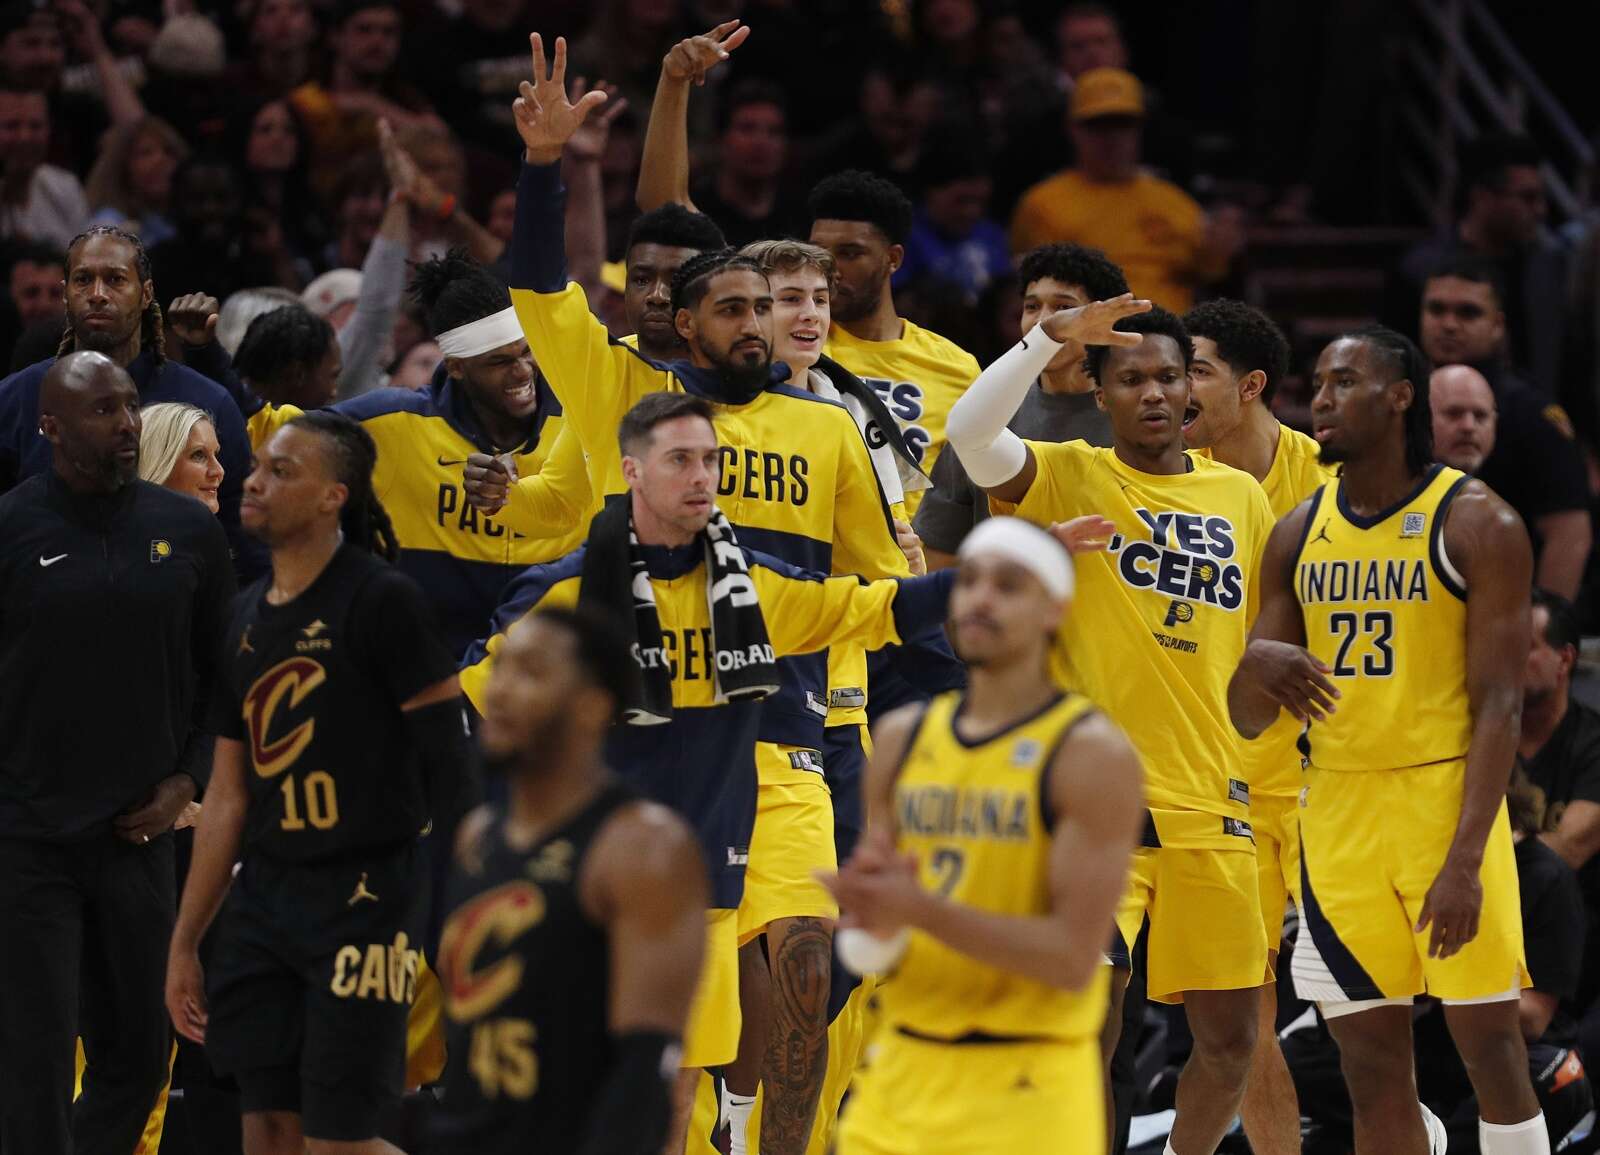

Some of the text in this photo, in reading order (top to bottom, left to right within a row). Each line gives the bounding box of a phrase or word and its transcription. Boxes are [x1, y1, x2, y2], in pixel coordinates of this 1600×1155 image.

[1134, 508, 1236, 560] YES
[1299, 559, 1430, 605] INDIANA
[1329, 610, 1395, 678] 23
[280, 770, 340, 830] 10
[469, 1016, 539, 1099] 45
